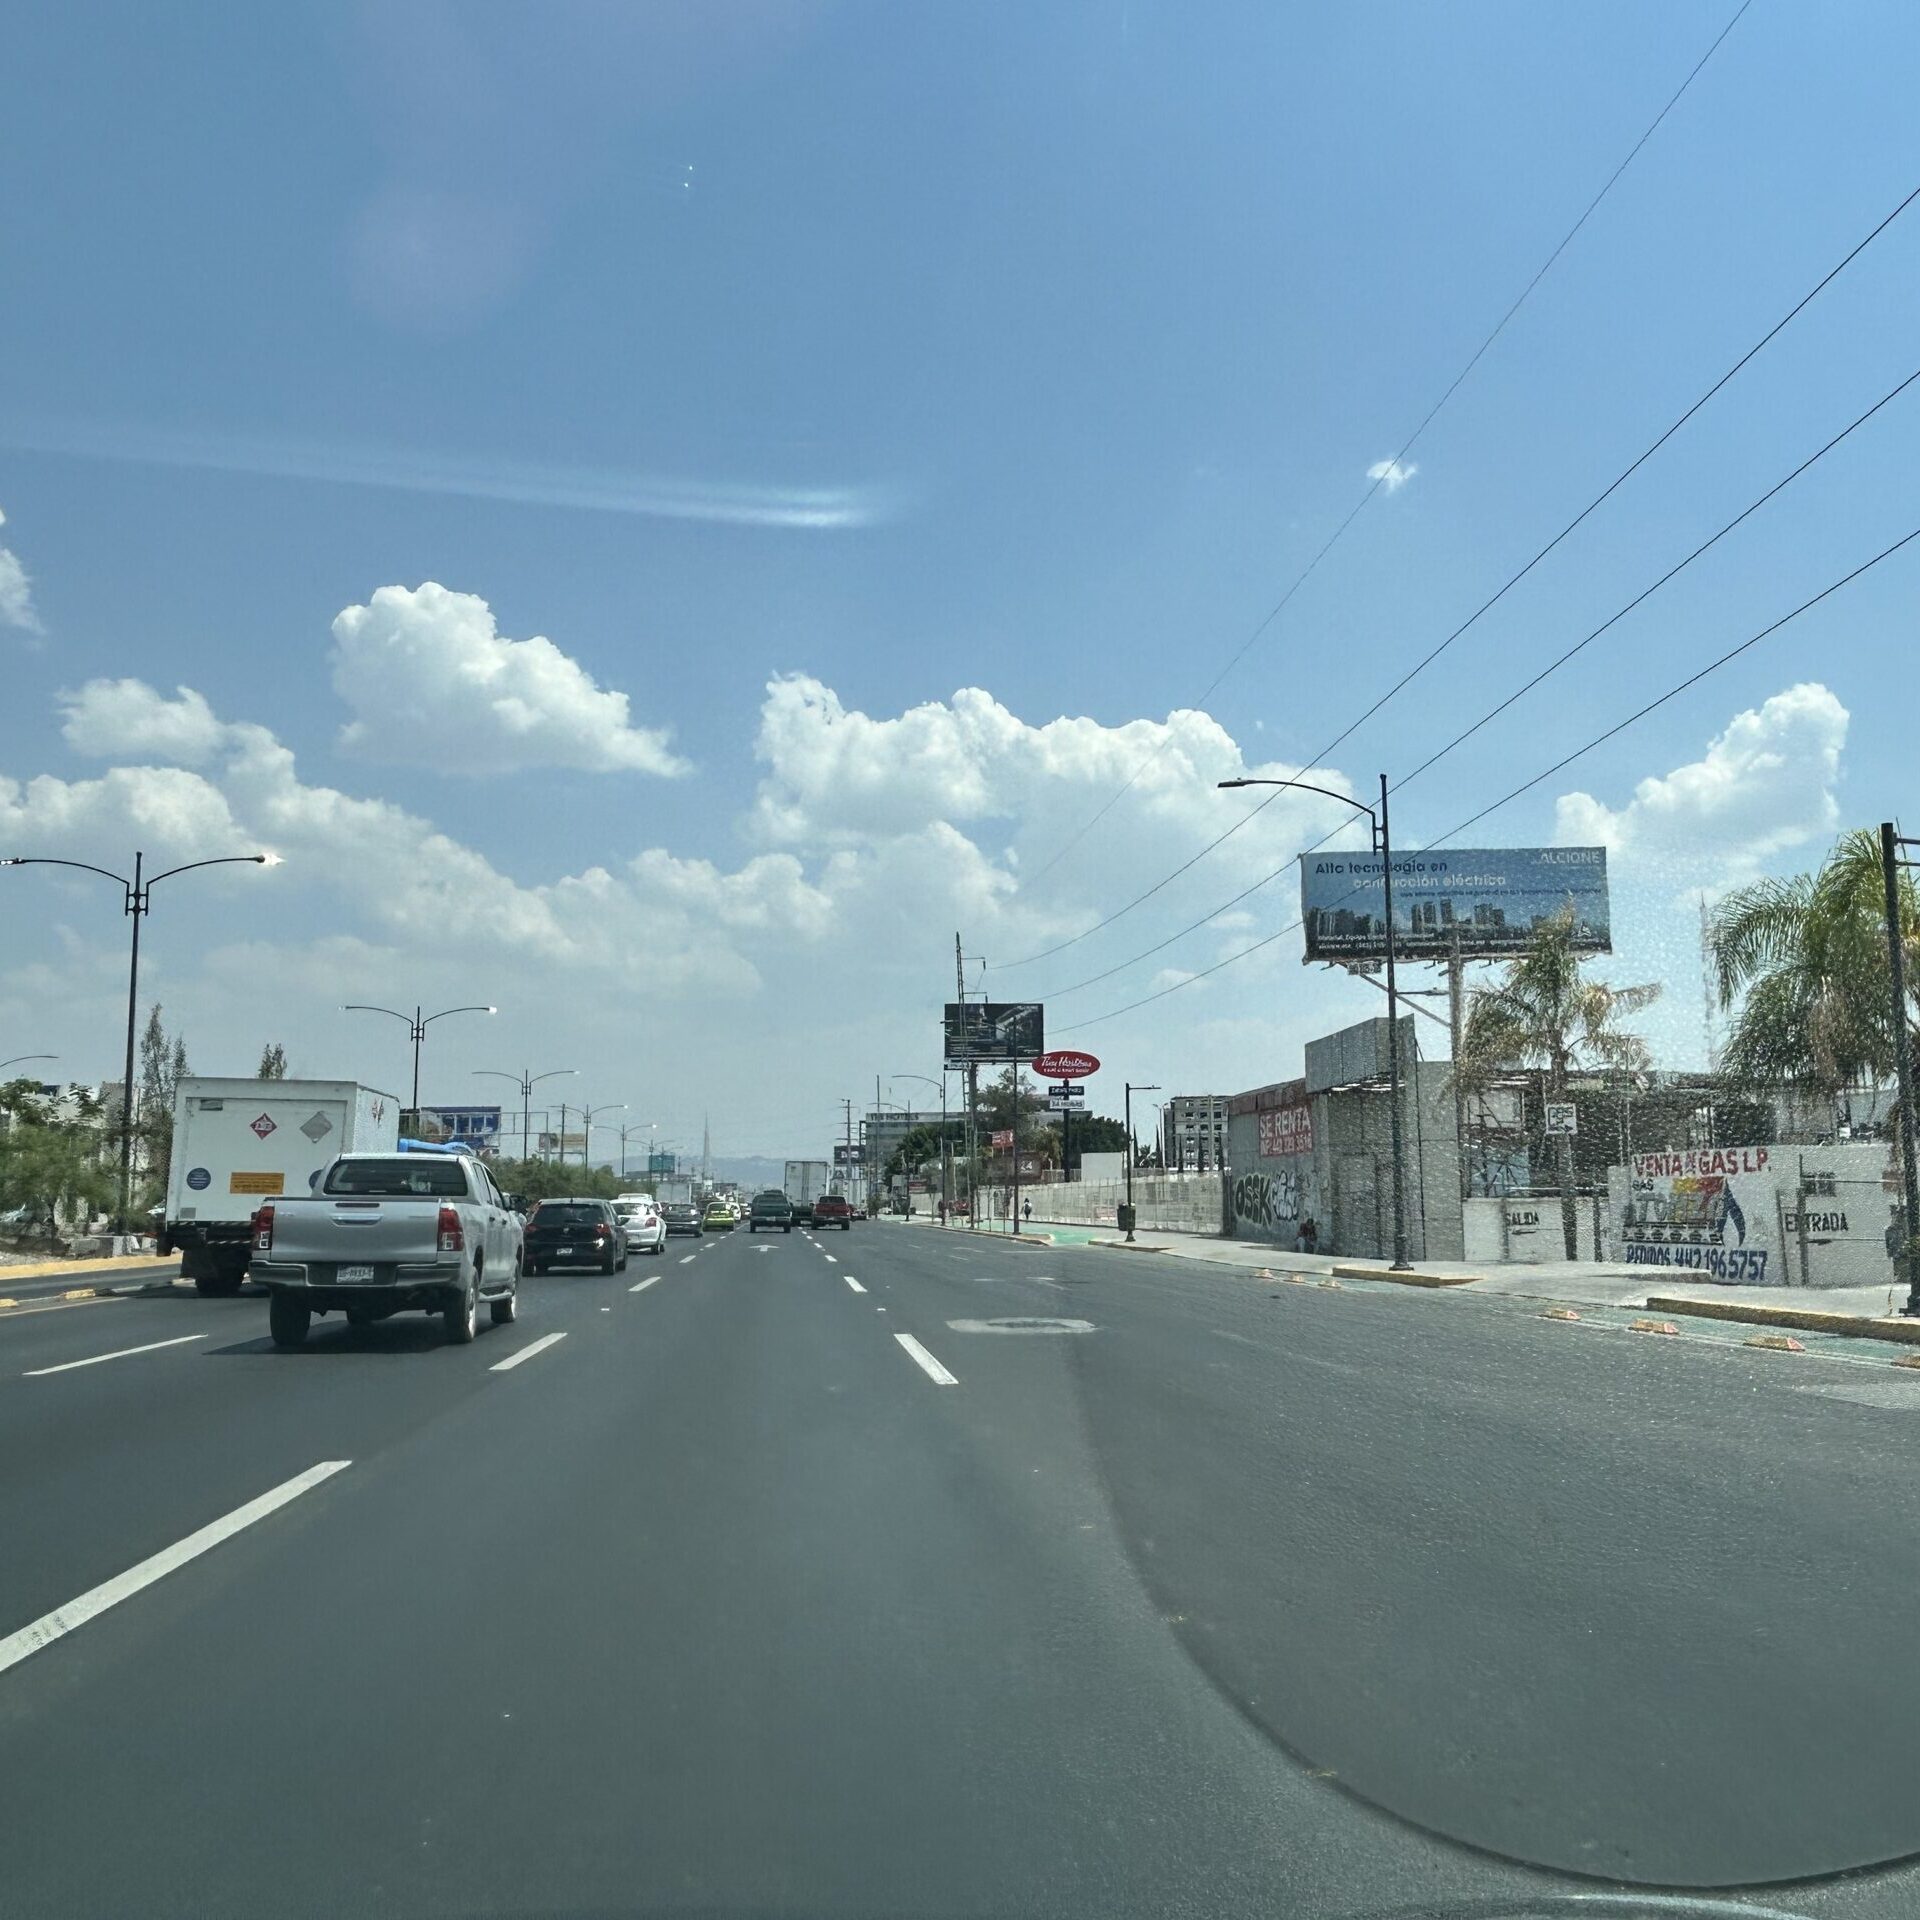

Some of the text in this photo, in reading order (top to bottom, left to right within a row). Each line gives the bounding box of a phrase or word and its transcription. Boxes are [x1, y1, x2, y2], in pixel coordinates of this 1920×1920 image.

[1540, 851, 1600, 864] ALCIONE
[1315, 862, 1344, 874] Alta
[1430, 862, 1448, 873] en
[1259, 1106, 1311, 1138] SE RENTA
[1633, 1153, 1683, 1177] VENTA
[1698, 1148, 1739, 1175] GAS
[1504, 1211, 1540, 1226] SALIDA
